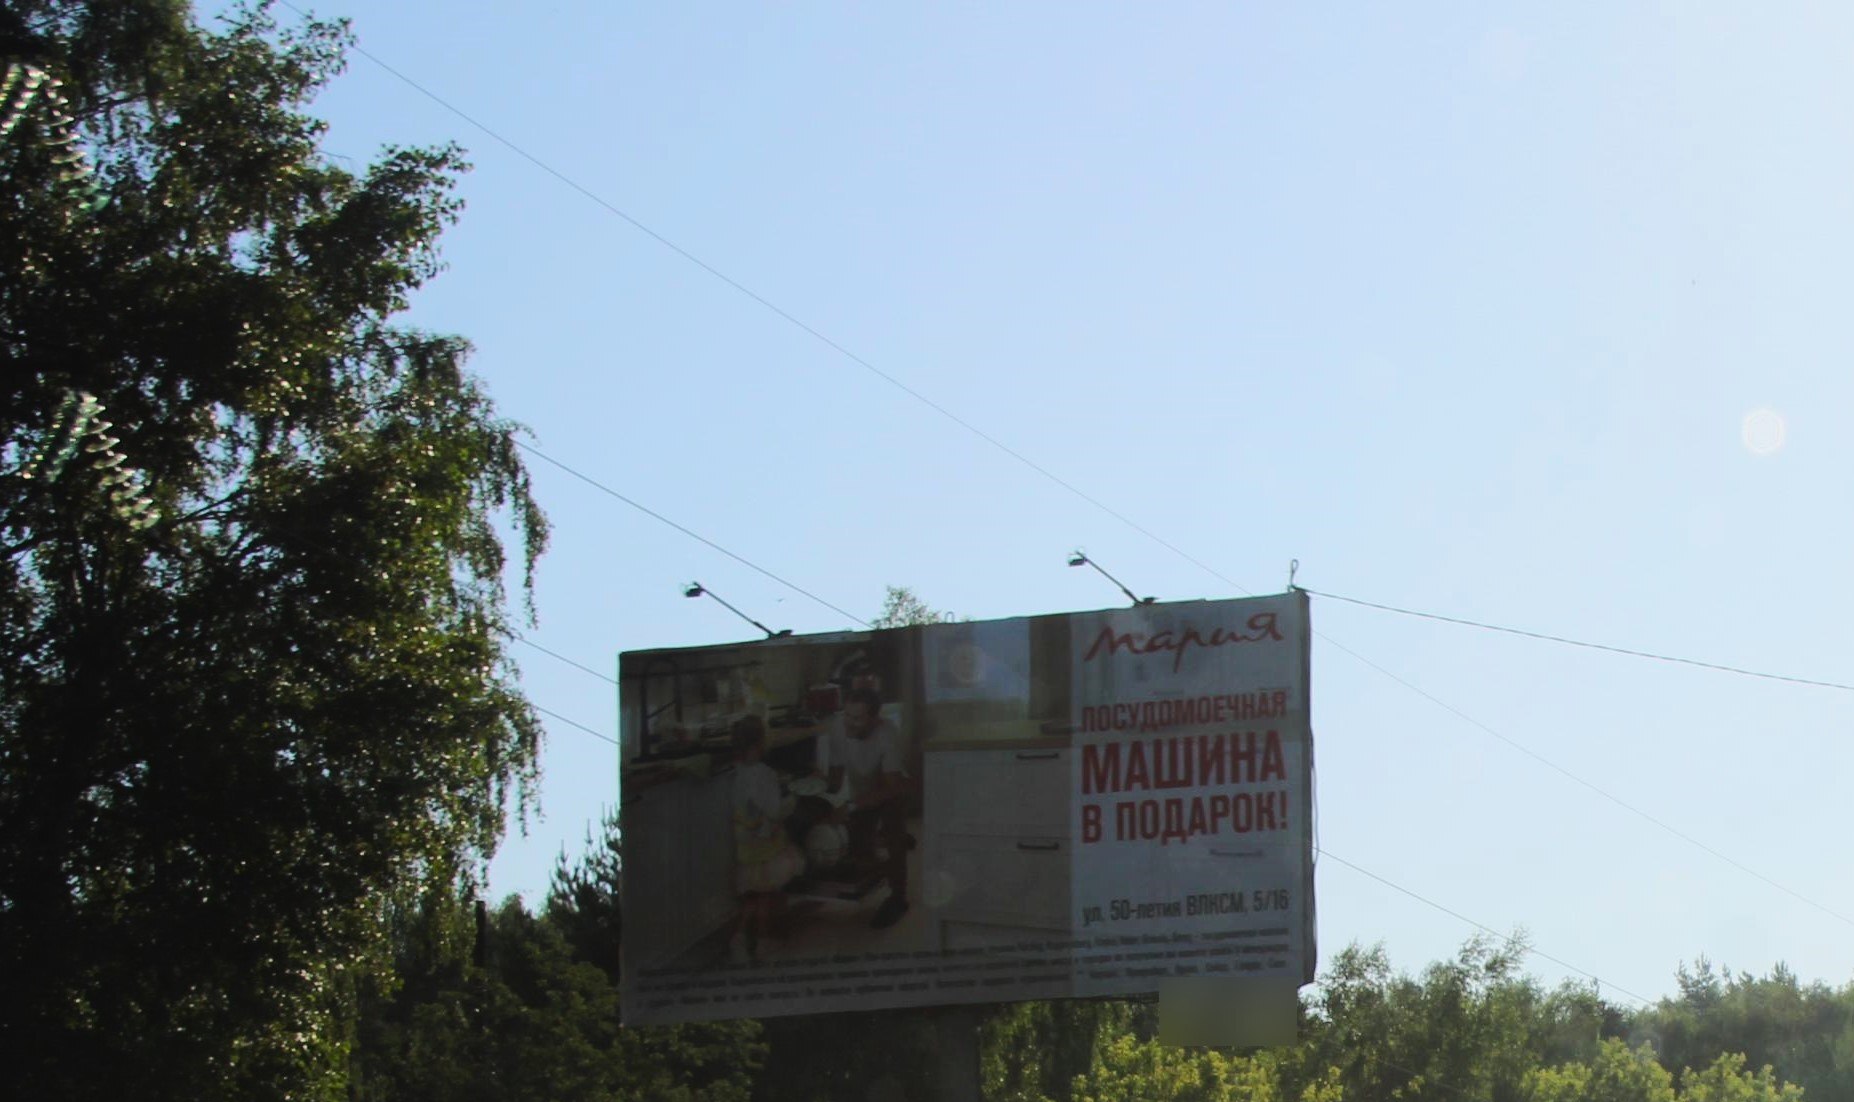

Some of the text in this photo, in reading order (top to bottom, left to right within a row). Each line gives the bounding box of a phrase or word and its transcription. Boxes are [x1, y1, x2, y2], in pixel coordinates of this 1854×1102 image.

[1083, 691, 1286, 732] ПОСУДОМОЕЧНАЯ
[1082, 731, 1286, 795] МАШИНА
[1082, 792, 1288, 845] В ПОДАРОК!
[1083, 905, 1104, 927] ул.
[1110, 899, 1180, 921] 50-летия
